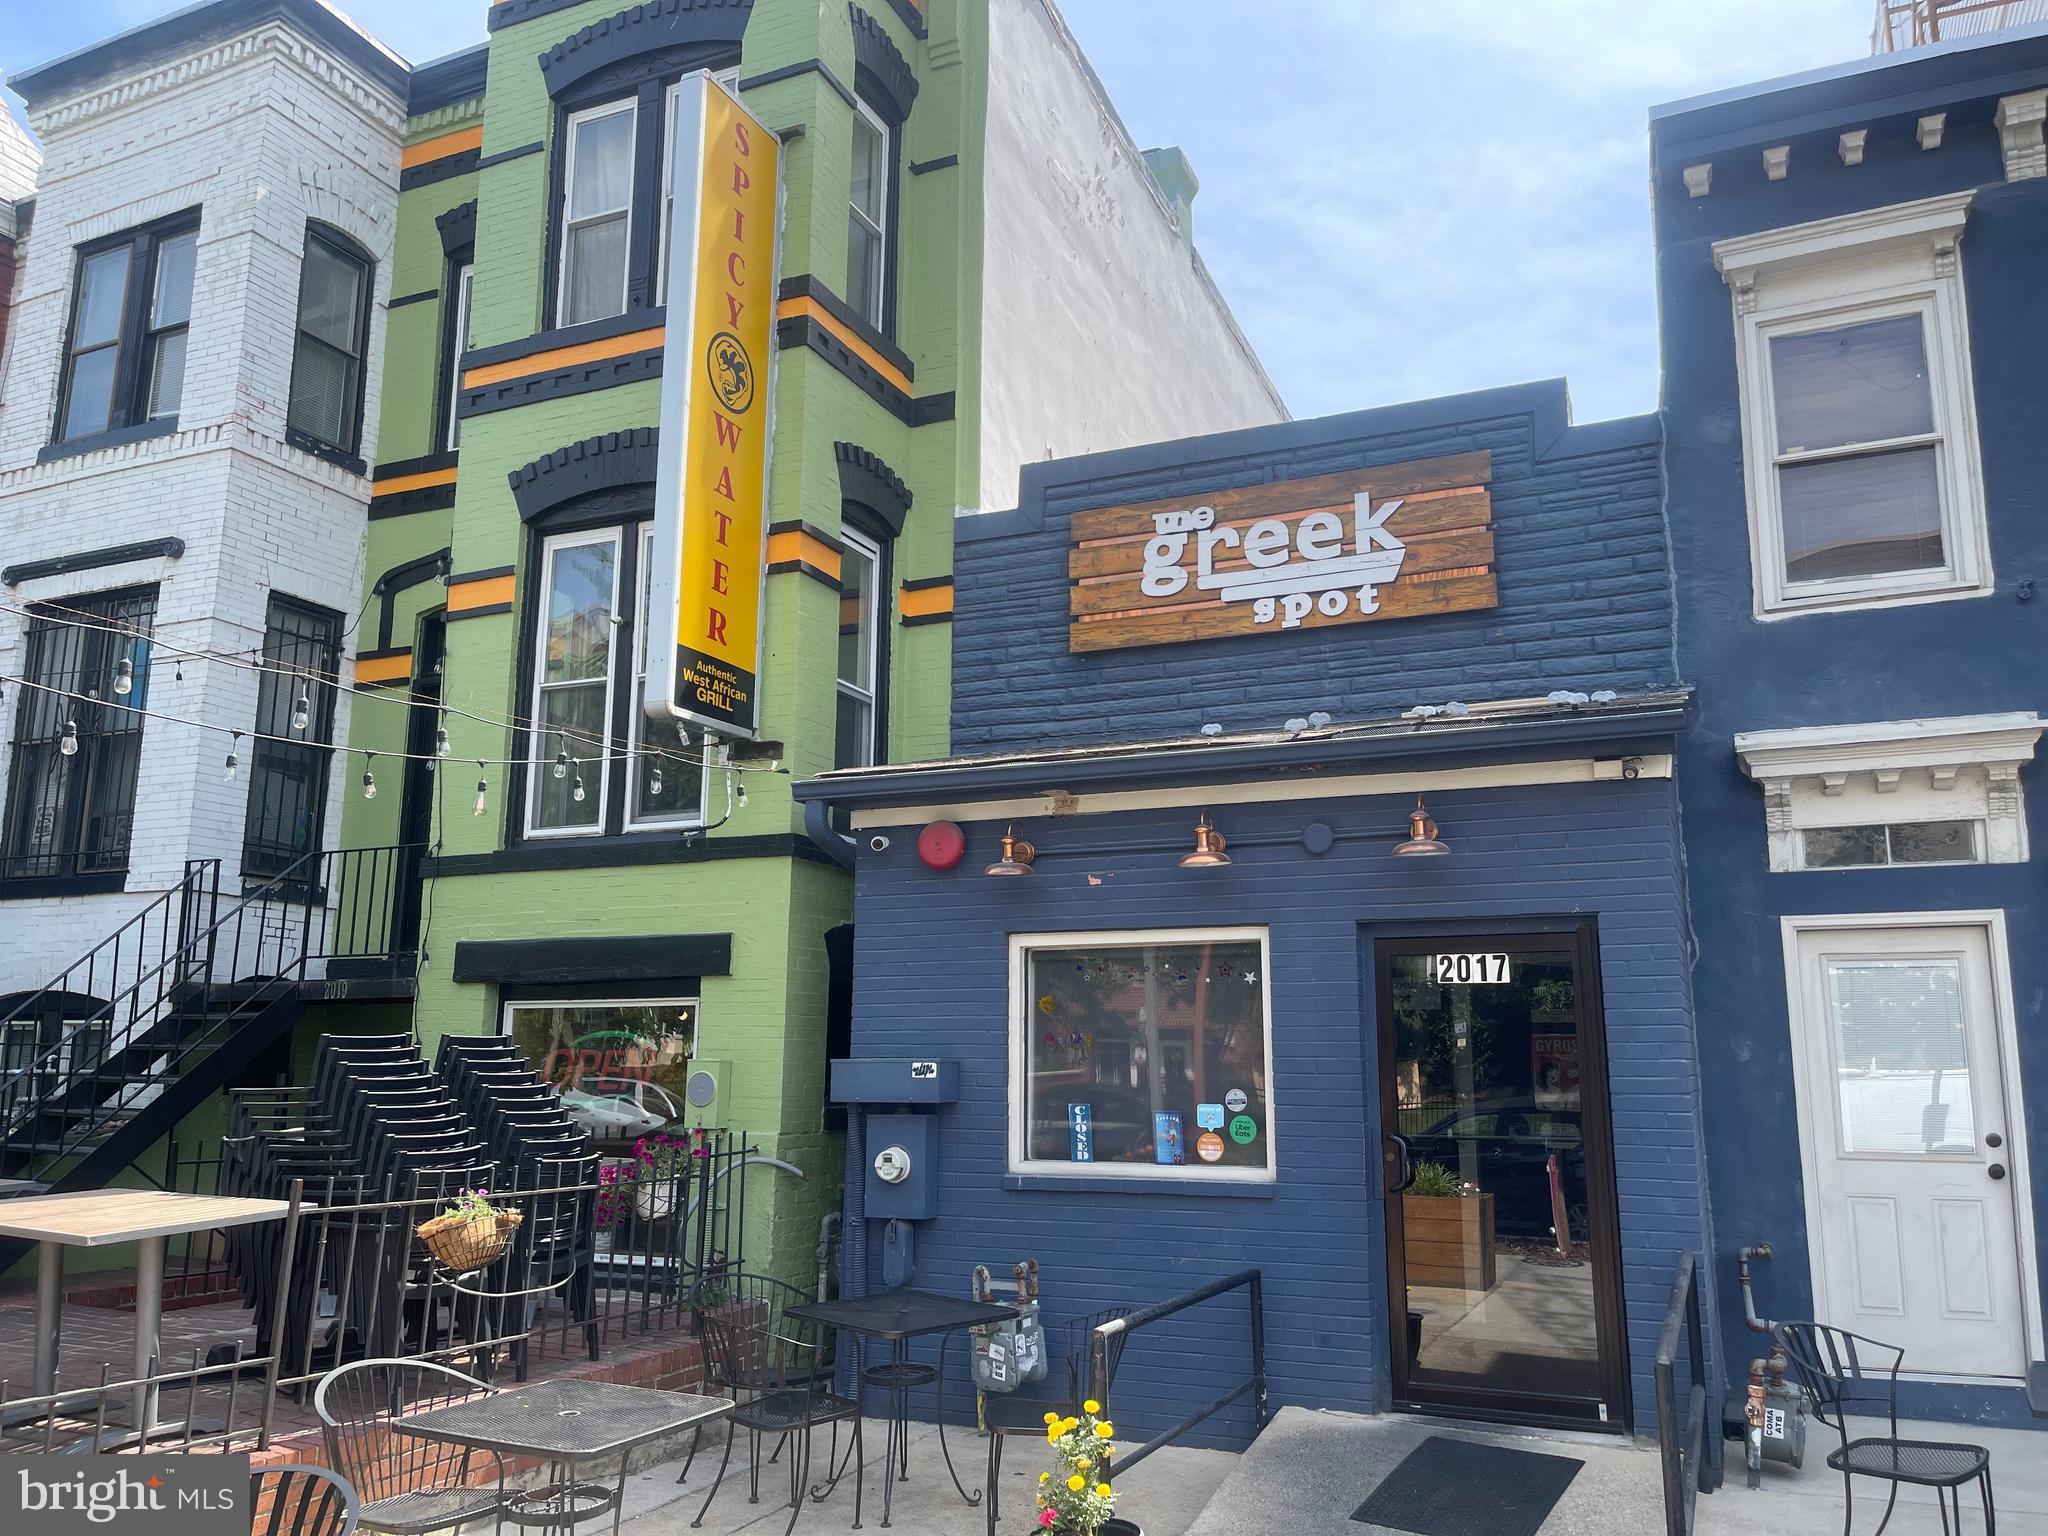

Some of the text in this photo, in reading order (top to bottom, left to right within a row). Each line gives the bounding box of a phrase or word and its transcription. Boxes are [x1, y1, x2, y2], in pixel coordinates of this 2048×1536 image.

[707, 122, 750, 647] SPICY WATER
[1140, 491, 1406, 598] greek
[1253, 584, 1380, 629] spot
[683, 667, 747, 703] West African
[696, 660, 737, 684] Authentic
[696, 687, 734, 712] GRILL
[1439, 954, 1506, 982] 2017
[324, 981, 348, 999] 2019
[542, 1048, 658, 1092] OPEN
[1074, 1105, 1090, 1160] CLOSED
[1235, 1123, 1251, 1131] Uber
[1766, 1410, 1774, 1436] COMA
[1775, 1416, 1783, 1434] ATB
